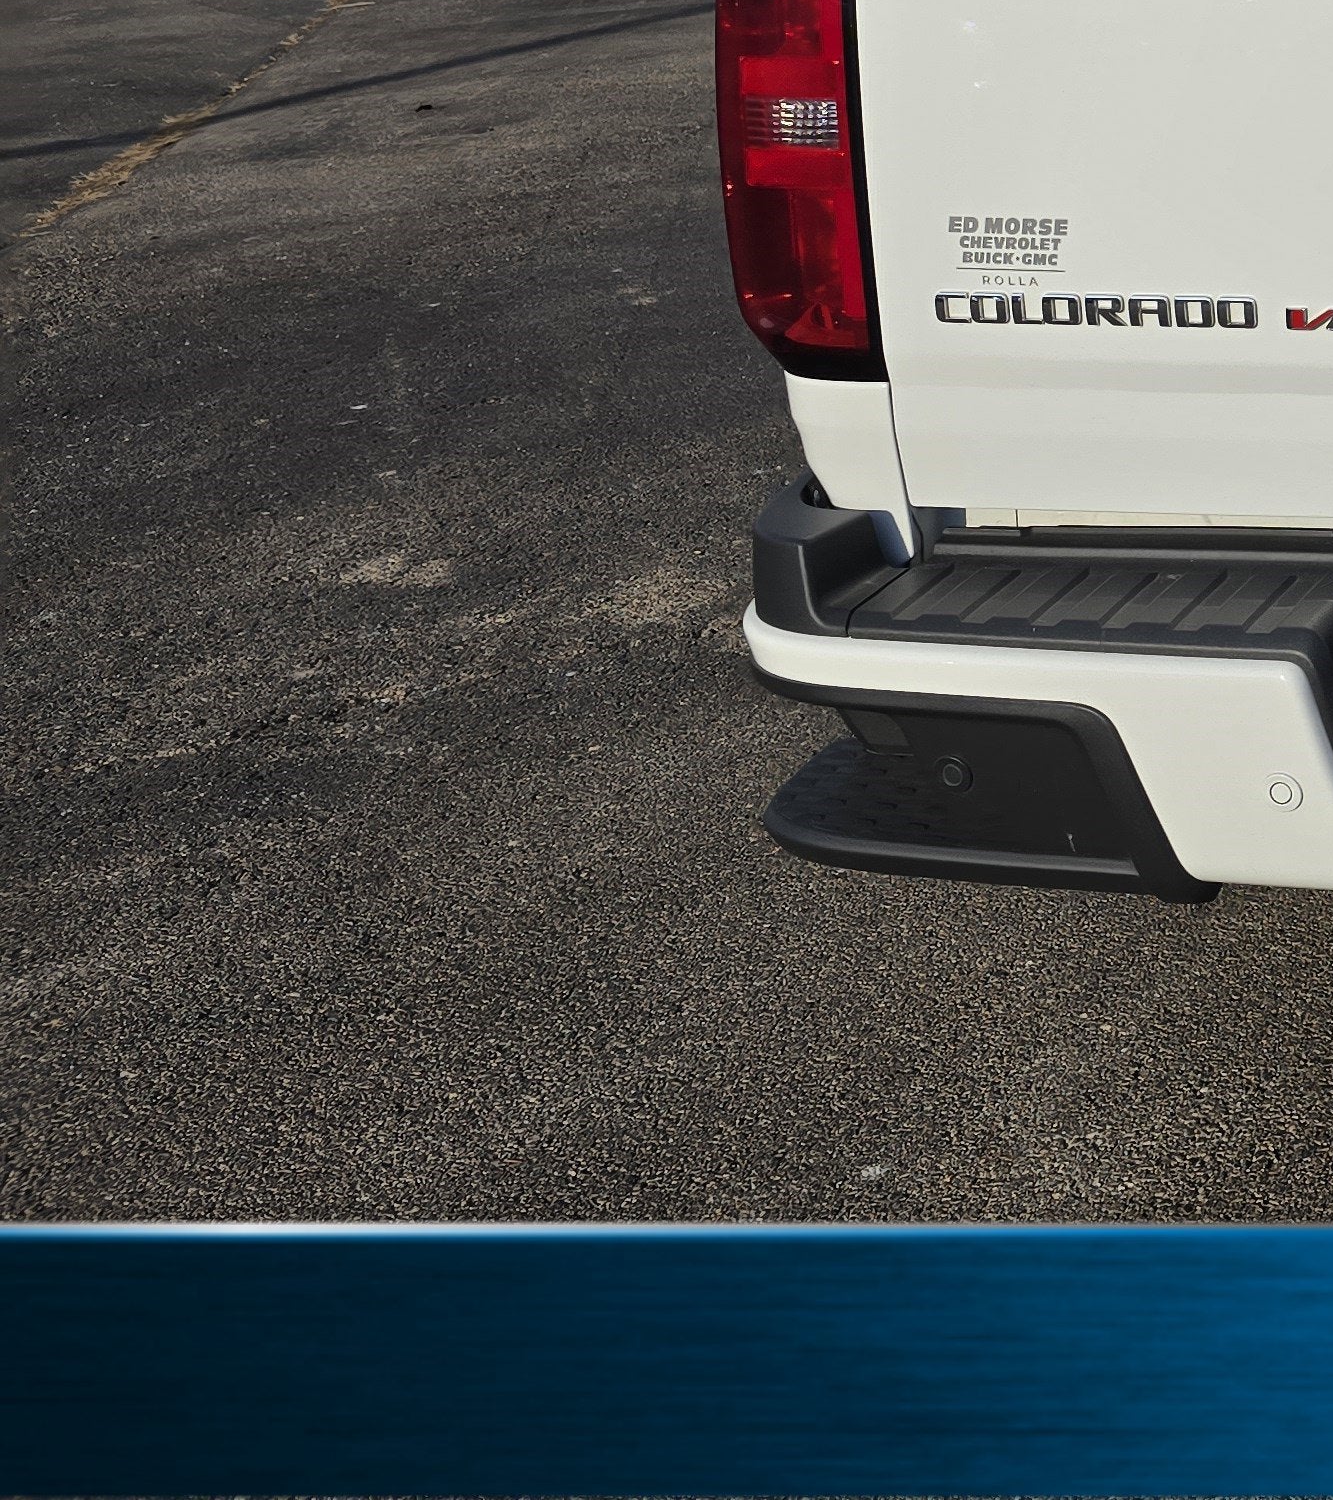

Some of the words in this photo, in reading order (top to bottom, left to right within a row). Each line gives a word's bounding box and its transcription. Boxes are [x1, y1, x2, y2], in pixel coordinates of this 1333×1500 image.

[948, 216, 979, 234] ED
[984, 217, 1069, 236] MORSE
[959, 235, 1062, 251] CHEVROLET
[982, 275, 1039, 287] ROLLA
[934, 291, 1259, 330] COLORADO
